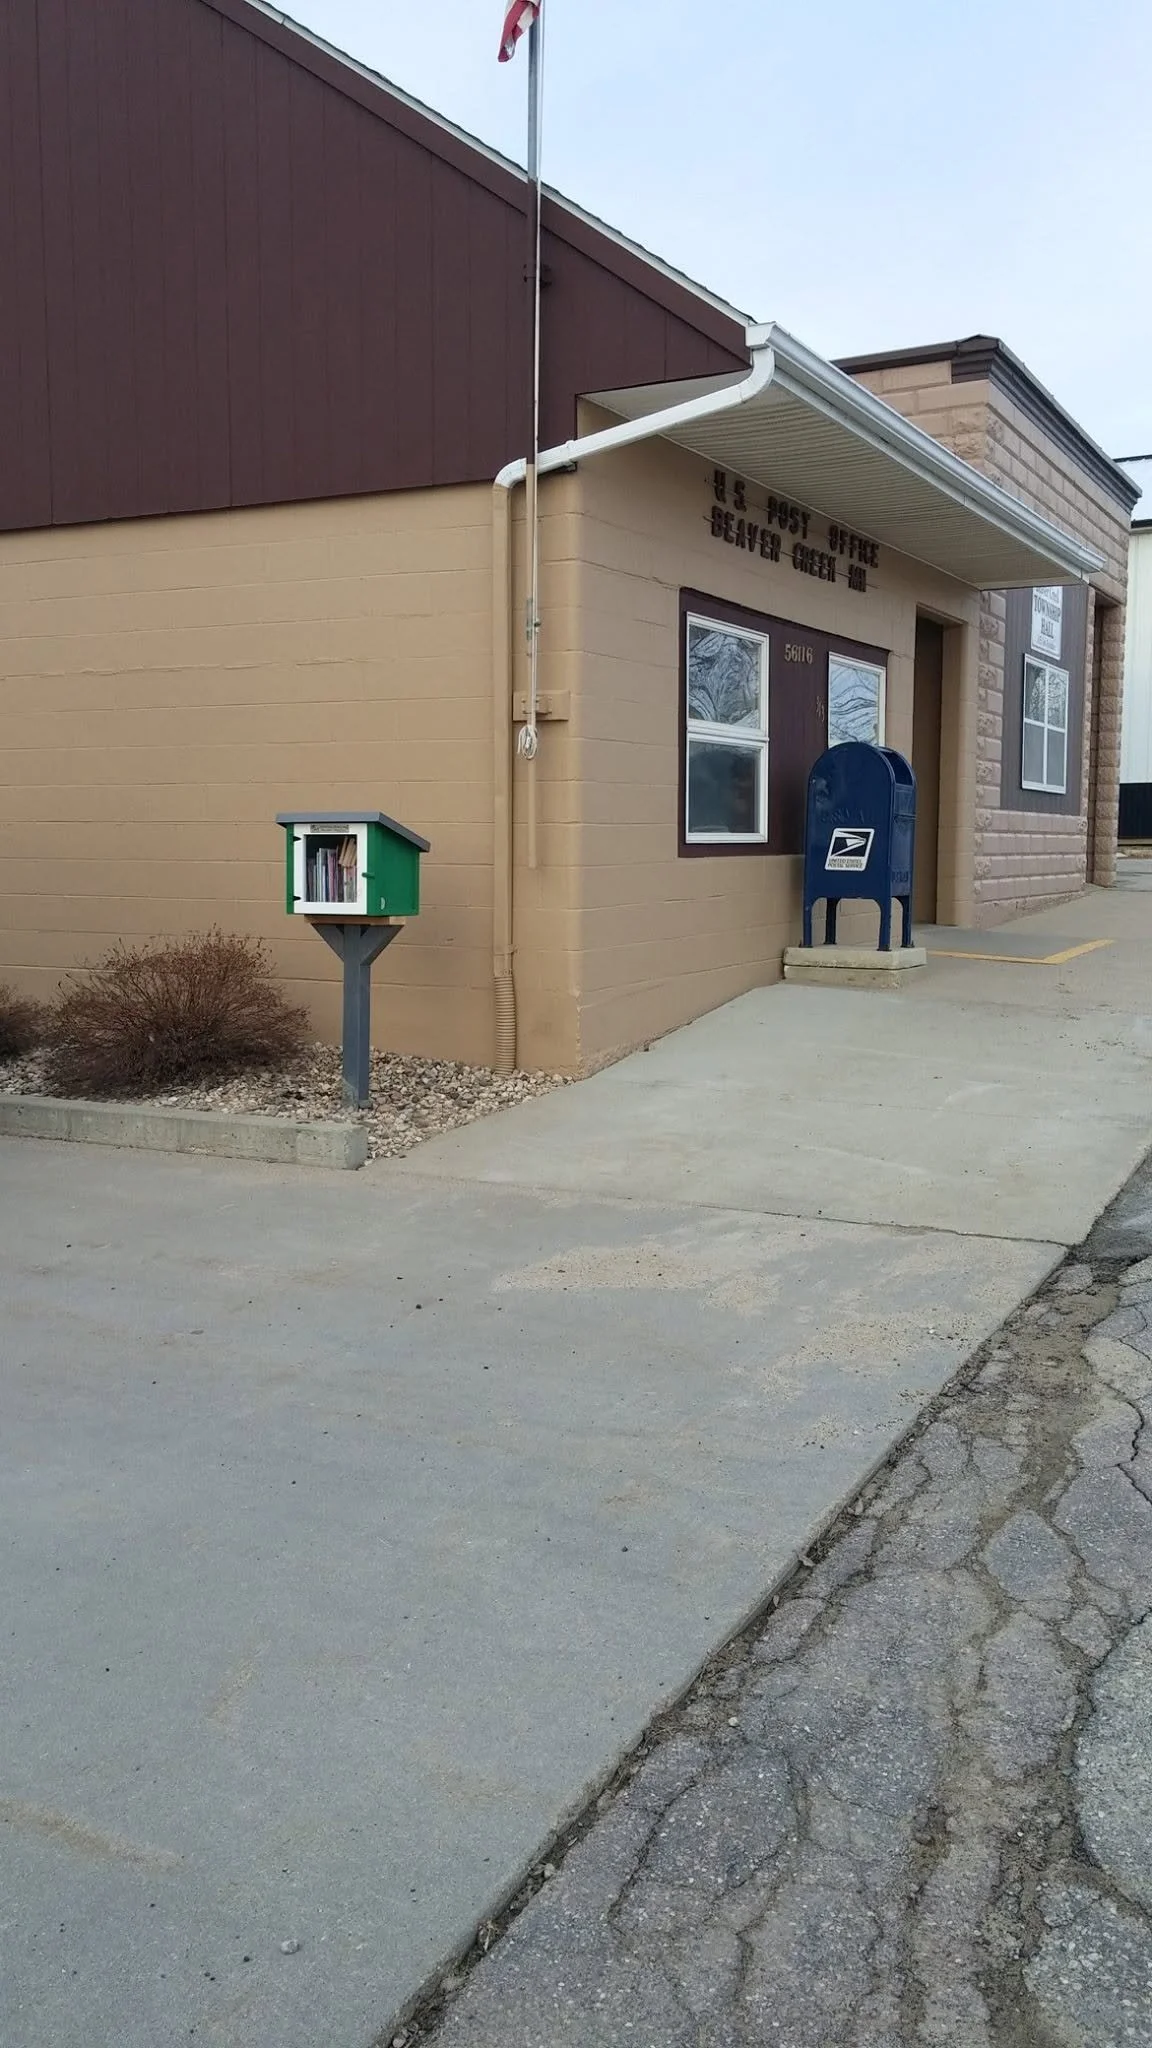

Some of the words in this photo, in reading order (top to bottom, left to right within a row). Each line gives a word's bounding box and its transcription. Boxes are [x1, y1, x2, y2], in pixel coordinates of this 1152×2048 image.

[711, 505, 782, 562] BEAVER
[792, 542, 837, 583] CREEK
[767, 495, 811, 539] POST
[828, 525, 880, 568] OFFICE
[1034, 594, 1061, 623] TOWNSHIP
[1041, 617, 1054, 639] HALL
[784, 643, 813, 665] 56116
